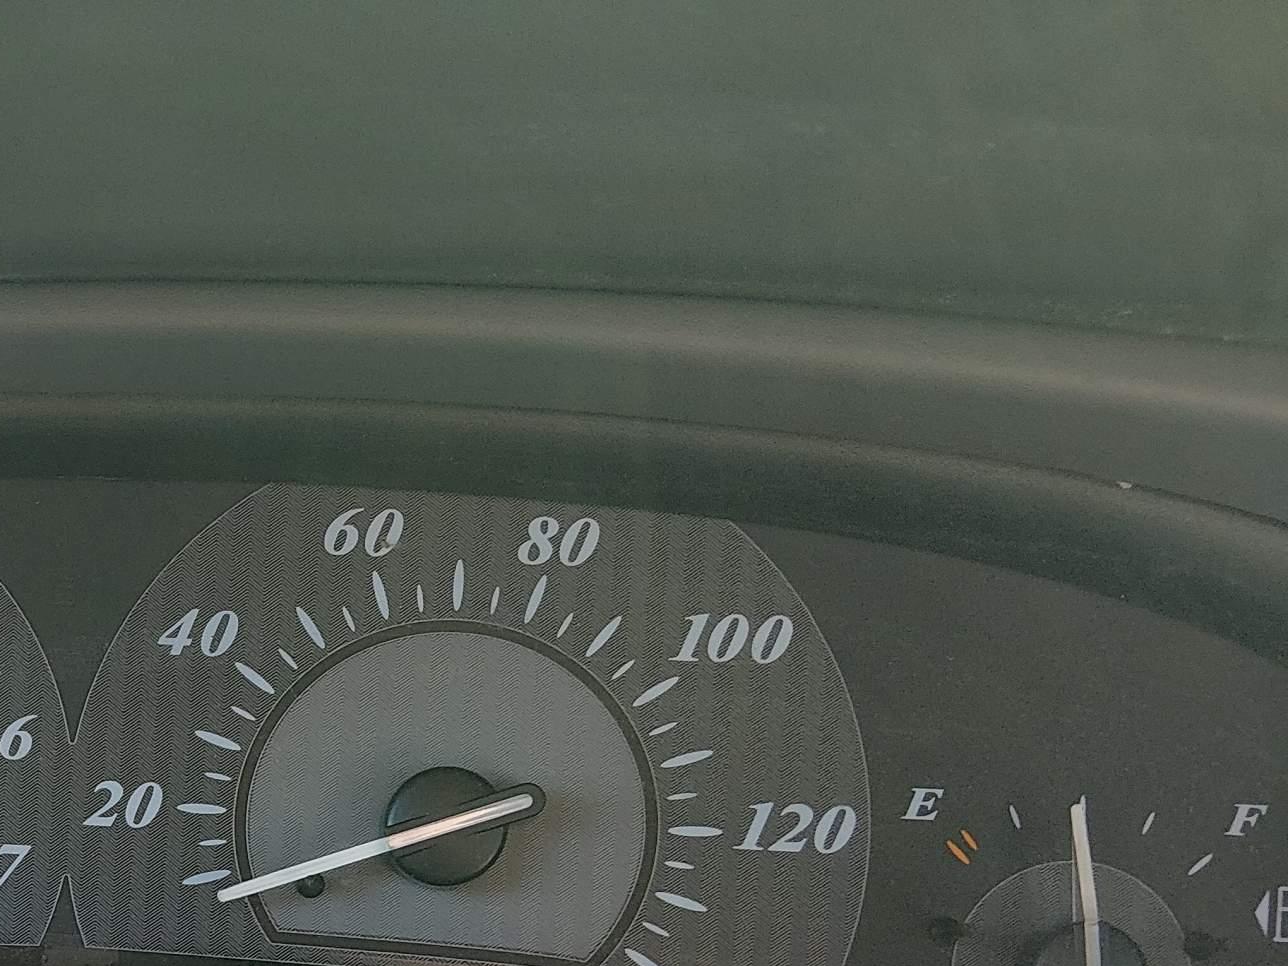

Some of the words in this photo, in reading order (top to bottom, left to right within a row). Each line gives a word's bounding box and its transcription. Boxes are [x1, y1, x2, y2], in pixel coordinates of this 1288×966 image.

[324, 507, 404, 557] 60
[518, 517, 601, 567] 80
[158, 609, 240, 659] 40
[669, 614, 794, 664] 100
[0, 715, 38, 760] 6
[83, 780, 162, 829] 20
[733, 802, 857, 855] 120
[900, 788, 944, 821] E
[1225, 803, 1268, 836] F
